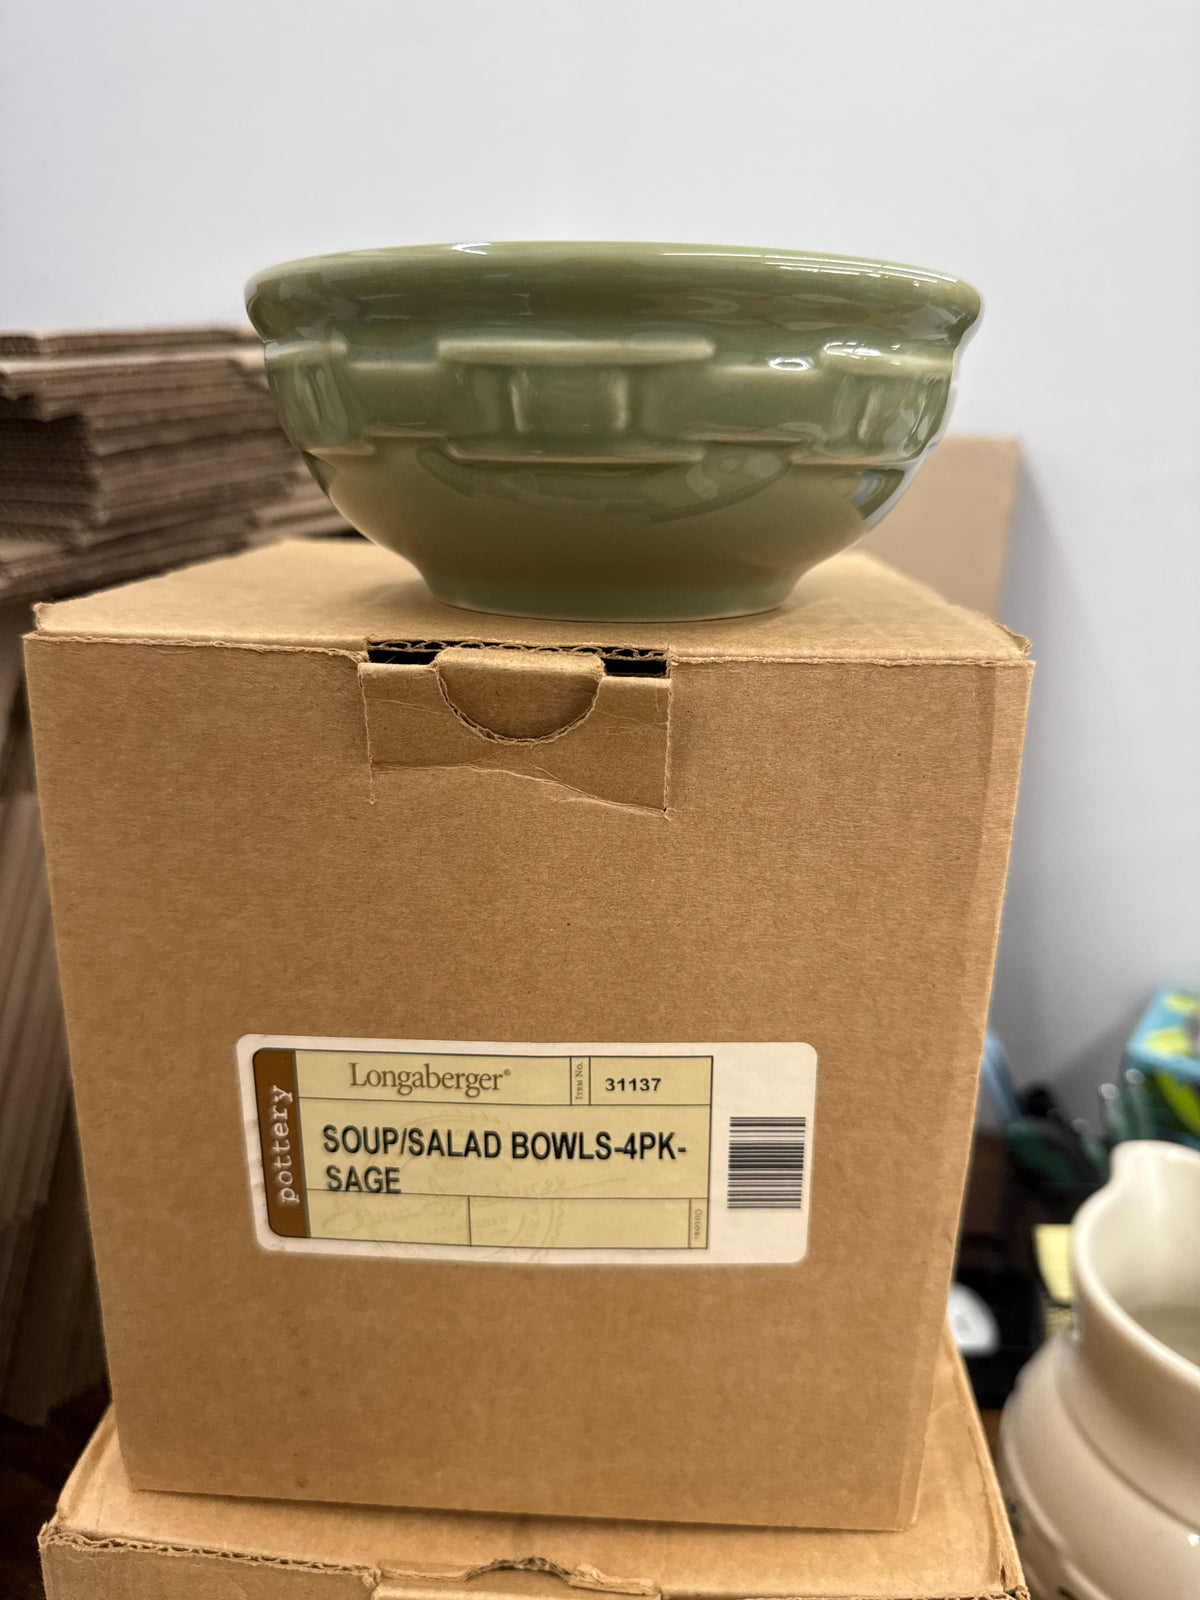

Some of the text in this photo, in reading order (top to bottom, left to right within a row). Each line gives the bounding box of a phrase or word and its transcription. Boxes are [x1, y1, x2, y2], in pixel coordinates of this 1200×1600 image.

[604, 1077, 662, 1092] 31137
[272, 1084, 299, 1204] pottery
[322, 1125, 687, 1161] SOUP/SALAD BOWLS-4PK-
[325, 1165, 402, 1194] SAGE
